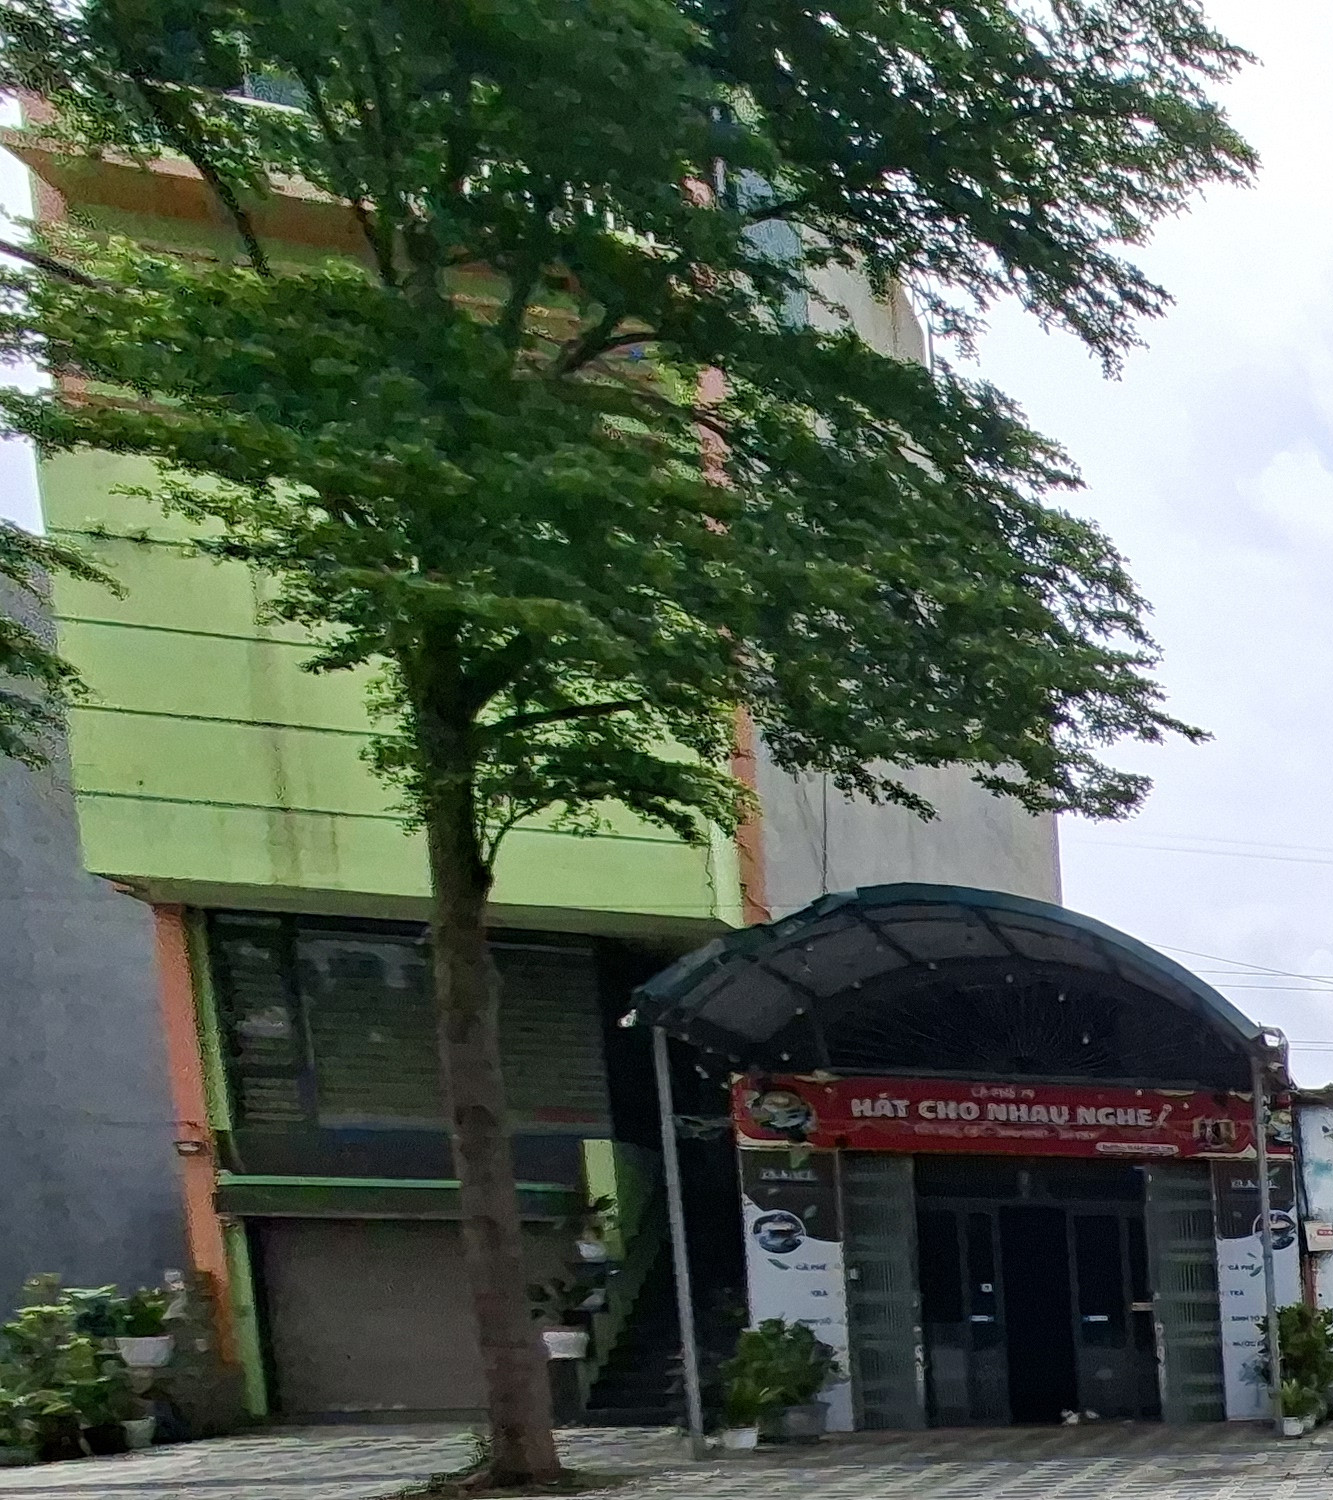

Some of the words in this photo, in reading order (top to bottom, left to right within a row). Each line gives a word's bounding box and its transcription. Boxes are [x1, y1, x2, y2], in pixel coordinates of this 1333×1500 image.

[850, 1092, 911, 1118] HÁT
[917, 1100, 980, 1121] CHO
[987, 1102, 1071, 1125] NHAU
